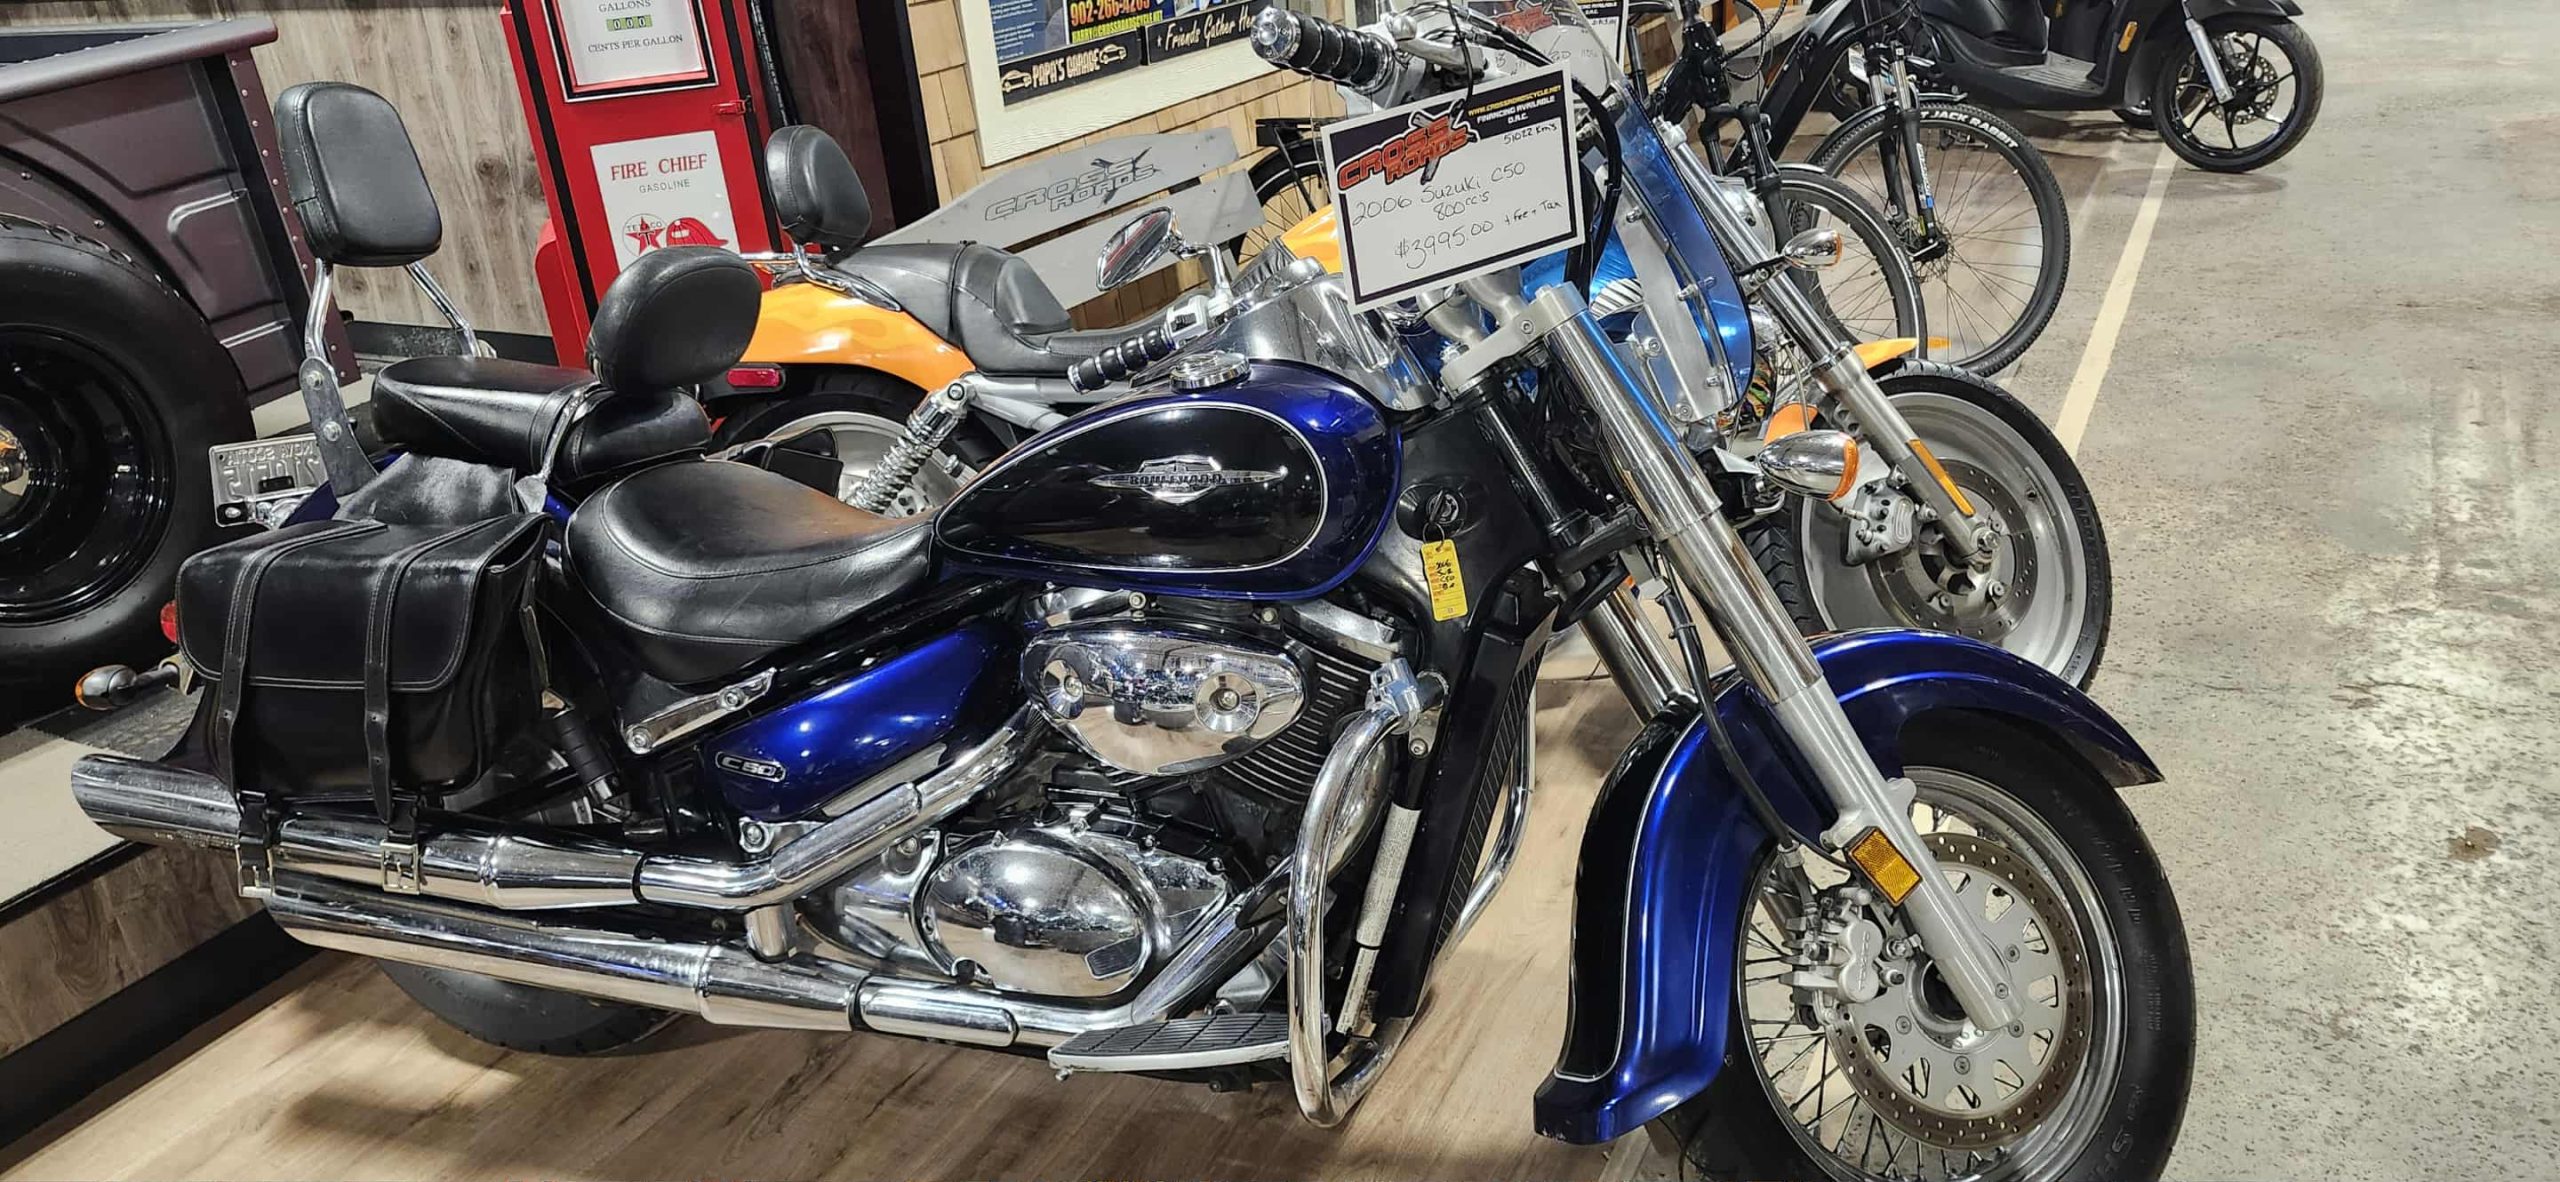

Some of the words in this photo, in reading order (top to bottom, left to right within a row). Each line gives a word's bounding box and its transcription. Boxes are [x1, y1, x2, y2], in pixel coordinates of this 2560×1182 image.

[598, 0, 652, 13] GALLONS
[588, 41, 620, 53] CENTS
[622, 39, 642, 49] PER
[642, 34, 683, 47] GALLON
[1165, 20, 1200, 50] Friends
[1203, 12, 1236, 47] Gather
[1238, 4, 1256, 32] Her
[1032, 57, 1065, 88] PAPA'S
[1066, 48, 1101, 79] GARAGE
[1476, 106, 1516, 124] FINANCING
[1516, 95, 1556, 112] AVAILABLE
[1929, 110, 1969, 122] JACK
[1969, 117, 2019, 148] RABBIT
[1338, 115, 1451, 189] CROSS
[1385, 126, 1469, 185] ROADS
[1503, 127, 1533, 145] 51022
[610, 161, 648, 181] FIRE
[658, 153, 707, 174] CHIEF
[639, 178, 690, 193] GASOLINE
[985, 157, 1135, 221] CROSS
[1050, 164, 1154, 212] ROADS
[1352, 195, 1412, 226] 2006
[1490, 161, 1525, 183] C50
[1394, 220, 1494, 270] $3995.00
[1539, 200, 1563, 211] Tax
